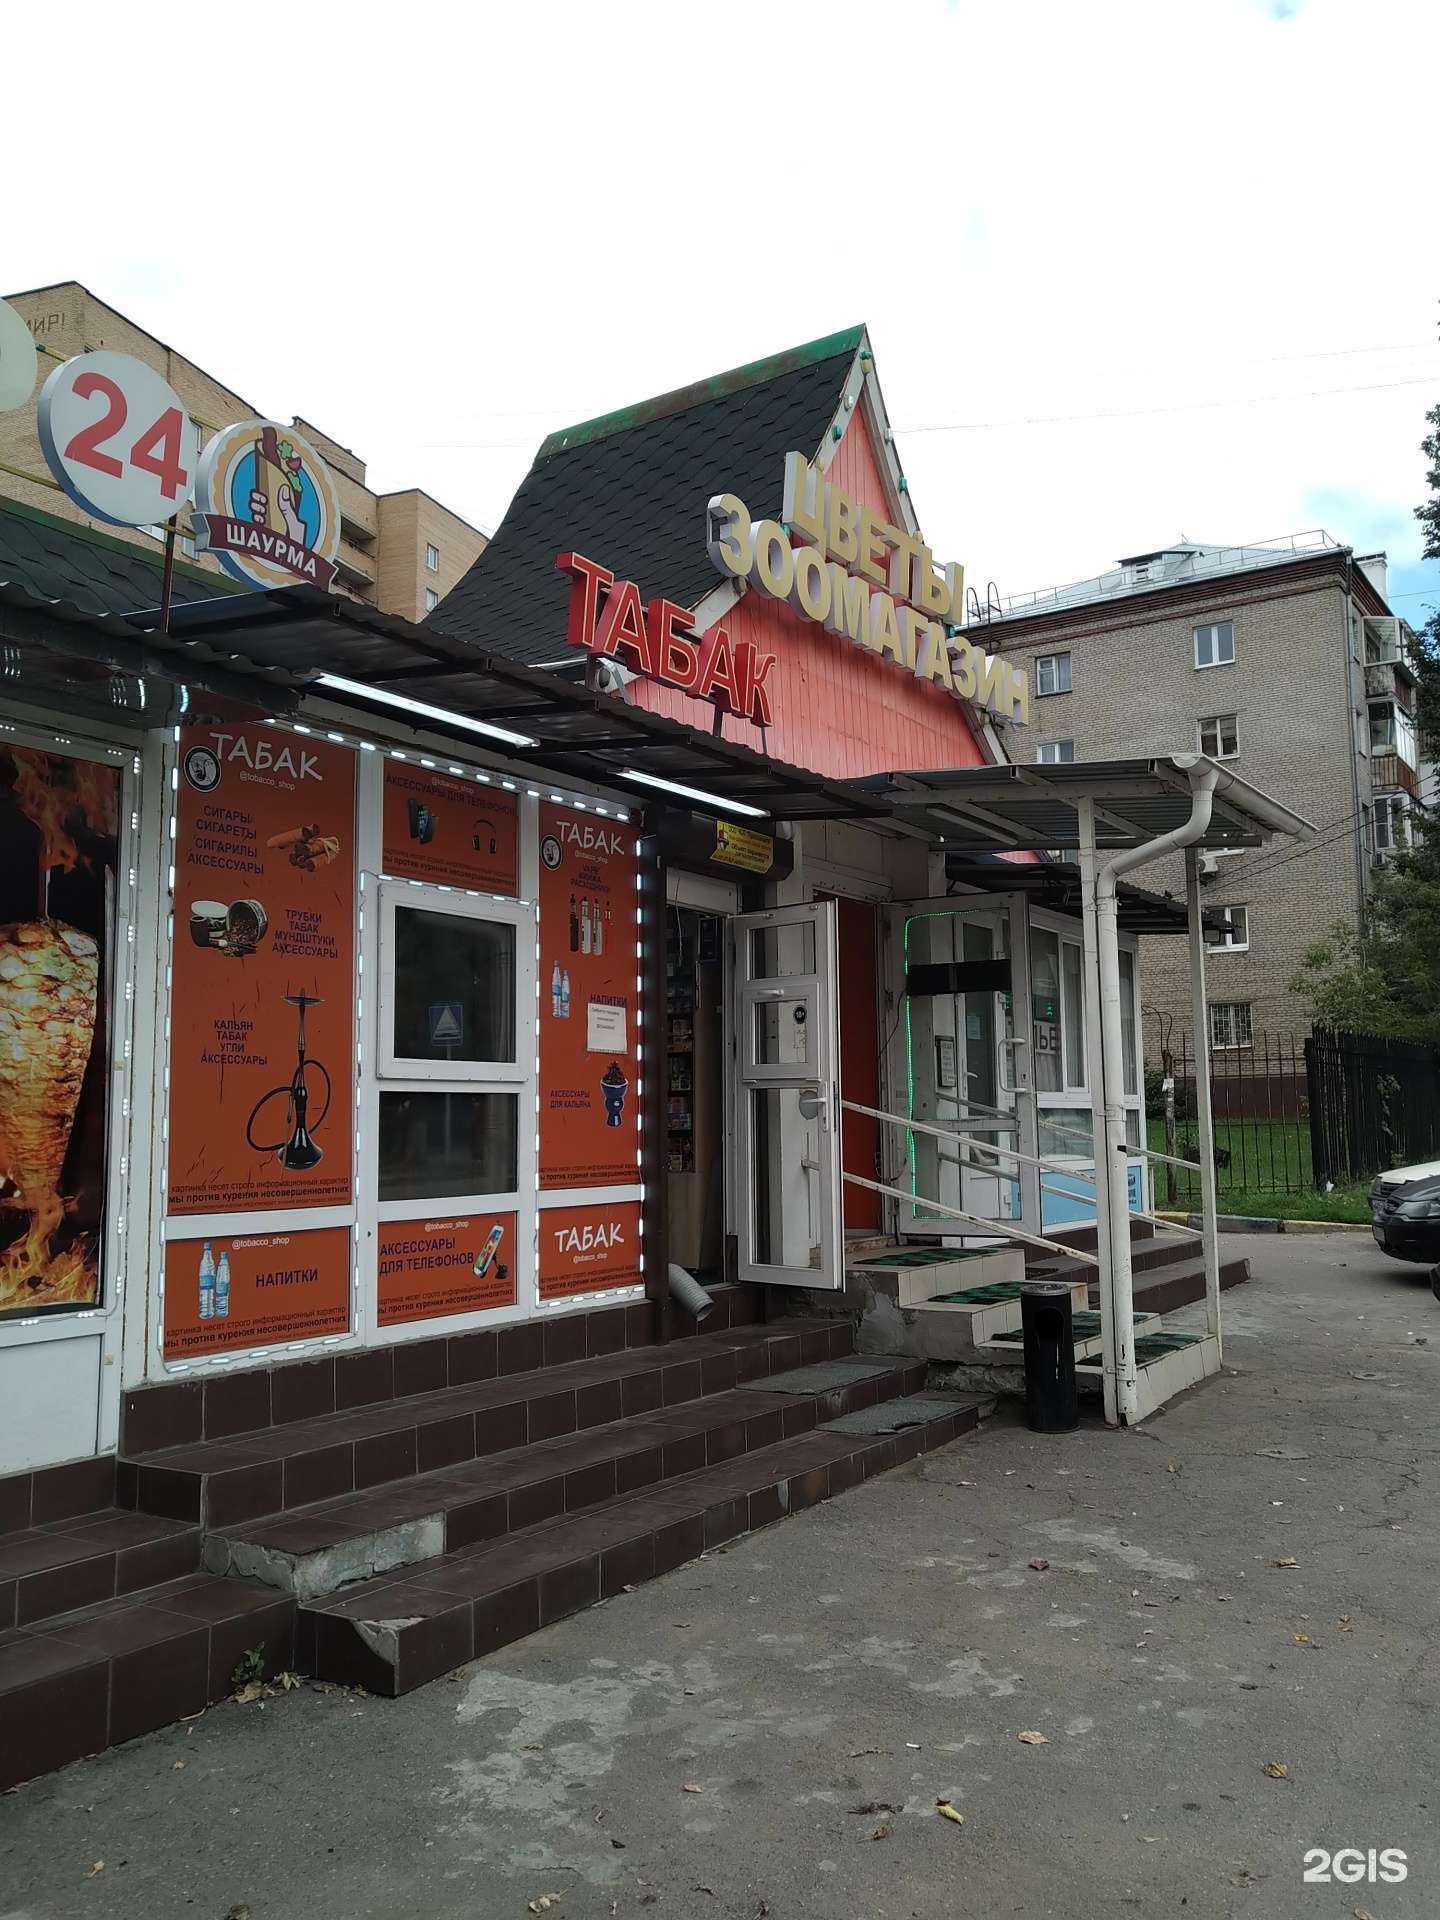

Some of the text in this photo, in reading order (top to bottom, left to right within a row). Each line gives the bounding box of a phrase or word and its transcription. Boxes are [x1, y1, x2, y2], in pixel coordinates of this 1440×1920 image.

[64, 371, 188, 501] 24
[782, 450, 964, 627] ЦВЕТЫ
[226, 523, 317, 578] ШАУРМА
[706, 493, 1029, 726] ЗООМАГАЗИН
[555, 551, 777, 727] ТАБАК
[209, 732, 323, 781] ТАБАК
[203, 805, 250, 823] СИГАРЫ
[196, 819, 257, 840] СИГАРЕТЫ
[556, 821, 625, 856] ТАБАК
[187, 853, 264, 874] АКСЕССУАРЫ
[286, 909, 322, 923] ТРУБКИ
[289, 920, 319, 933] ТАБАК
[274, 929, 335, 947] МУНДШТУКИ
[272, 942, 338, 959] АКСЕССУАРЫ
[214, 1019, 253, 1031] КАЛЬЯН
[217, 1030, 248, 1041] ТАБАК
[200, 1053, 268, 1065] АКСЕССУАРЫ
[186, 1192, 220, 1204] против
[222, 1190, 259, 1202] курения
[231, 1236, 290, 1250] @tobacco_shop
[380, 1237, 455, 1256] АКСЕССУАРЫ
[553, 1222, 625, 1253] ТАБАК
[379, 1252, 474, 1276] ДЛЯ ТЕЛЕФОНОВ
[255, 1268, 318, 1288] НАПИТКИ
[181, 1333, 215, 1347] против
[217, 1328, 255, 1342] курения
